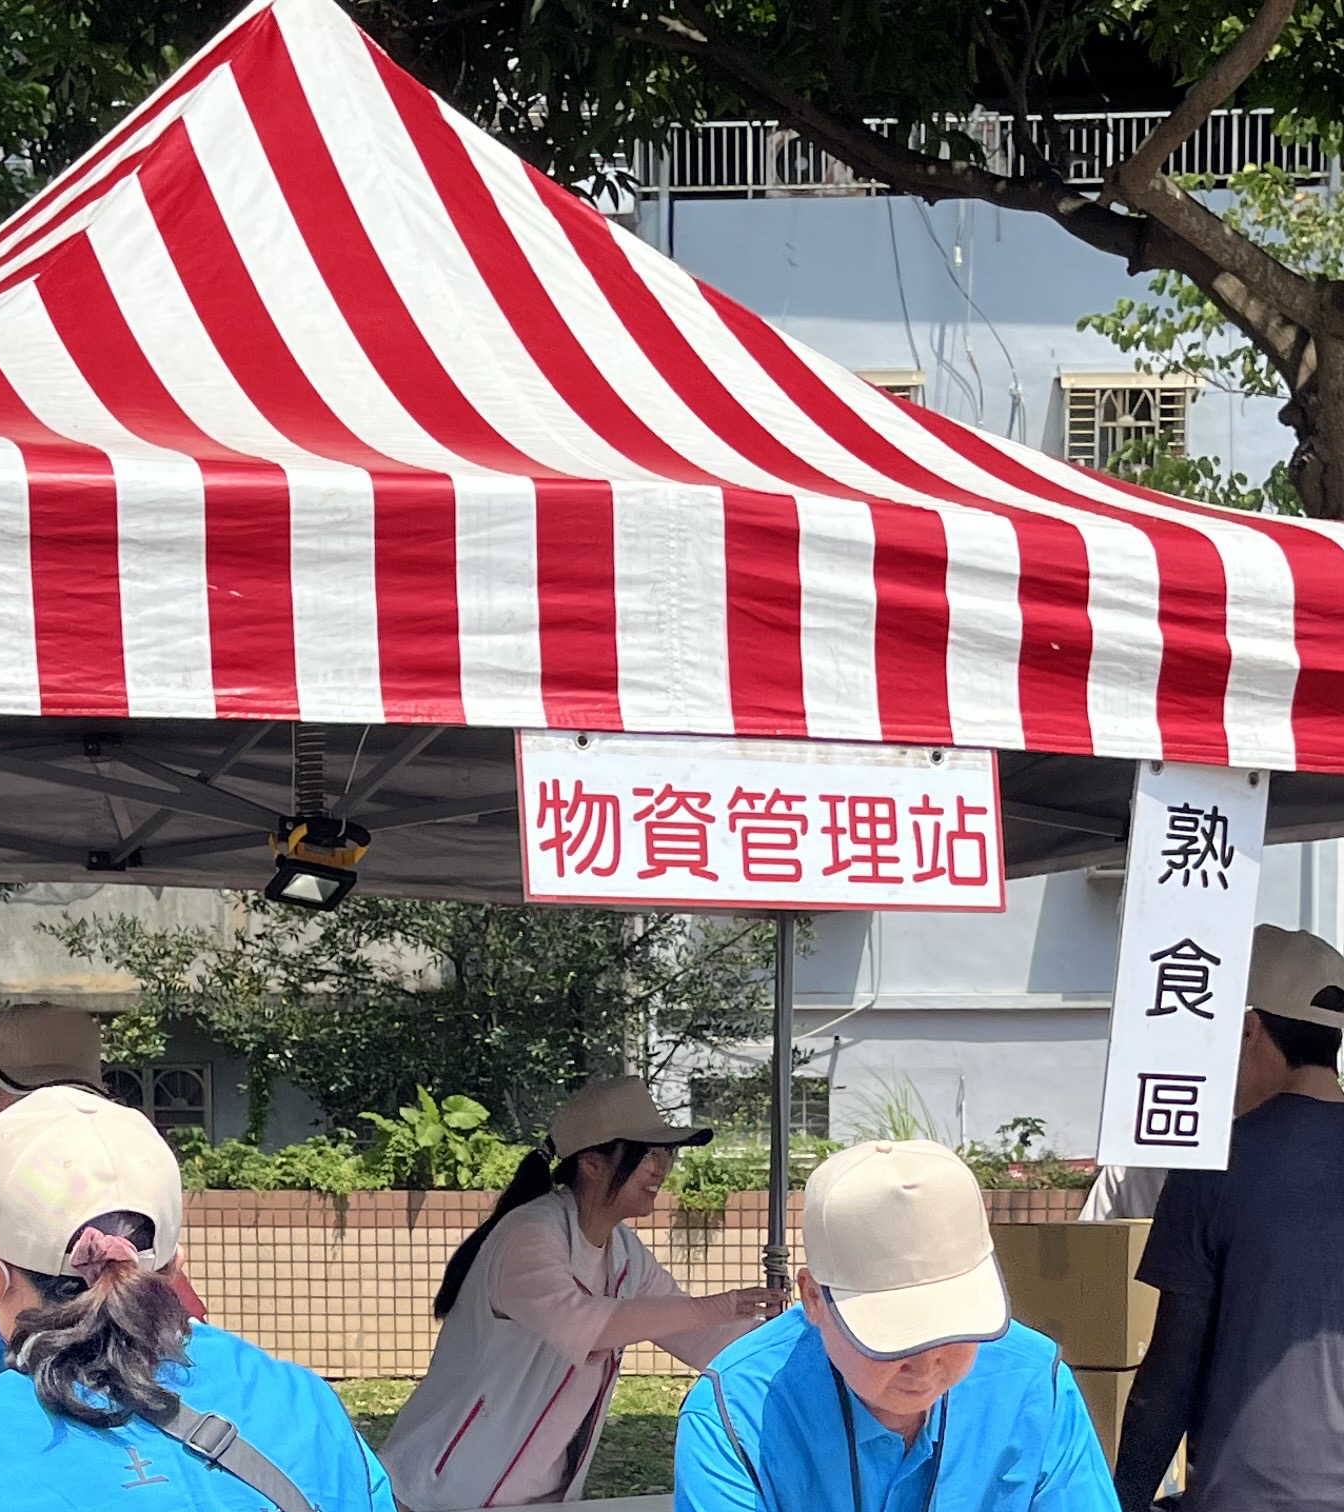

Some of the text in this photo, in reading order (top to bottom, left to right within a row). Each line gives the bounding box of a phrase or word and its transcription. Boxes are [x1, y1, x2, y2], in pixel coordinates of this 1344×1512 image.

[536, 778, 989, 887] 物資管理站
[1133, 802, 1234, 1147] 熟食區
